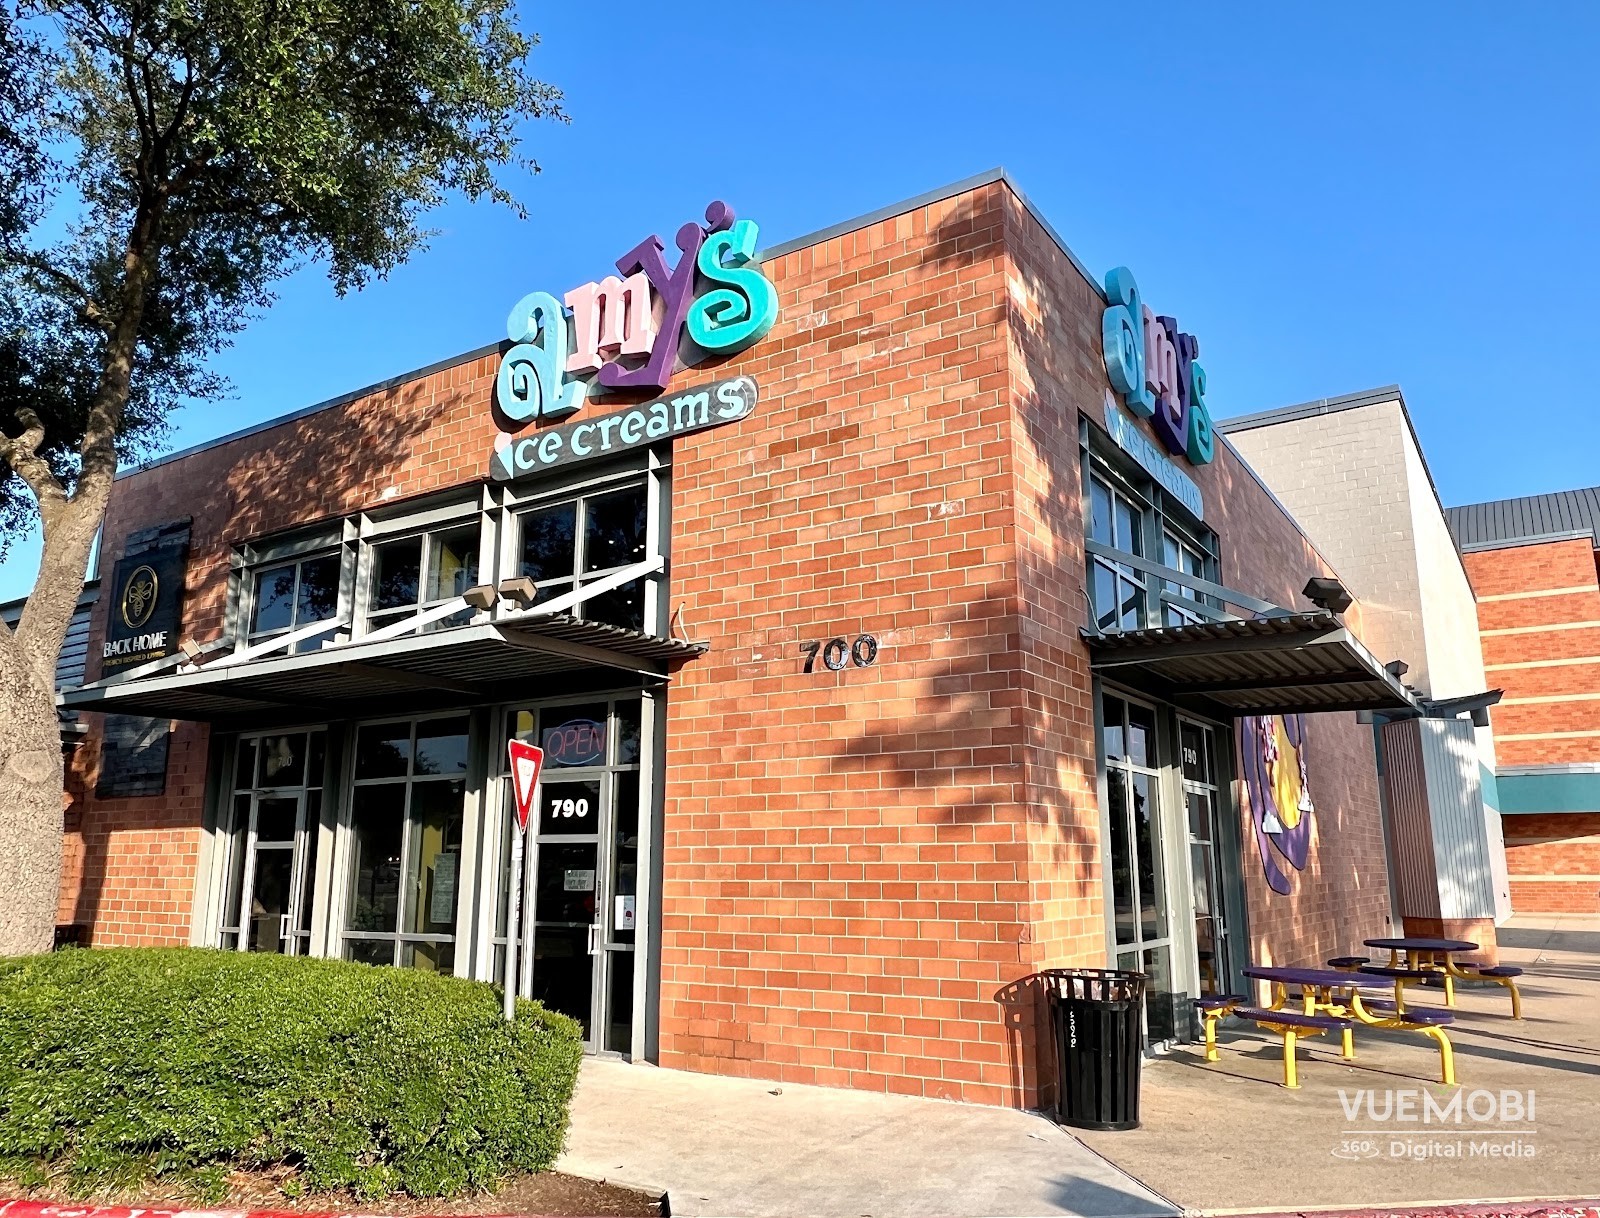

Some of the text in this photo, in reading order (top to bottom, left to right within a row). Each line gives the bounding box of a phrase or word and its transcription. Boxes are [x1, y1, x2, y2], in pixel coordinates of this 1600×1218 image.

[570, 377, 746, 457] creams
[103, 631, 167, 657] BACK HOME
[799, 633, 878, 674] 700
[547, 726, 607, 758] OPEN
[551, 798, 589, 818] 790
